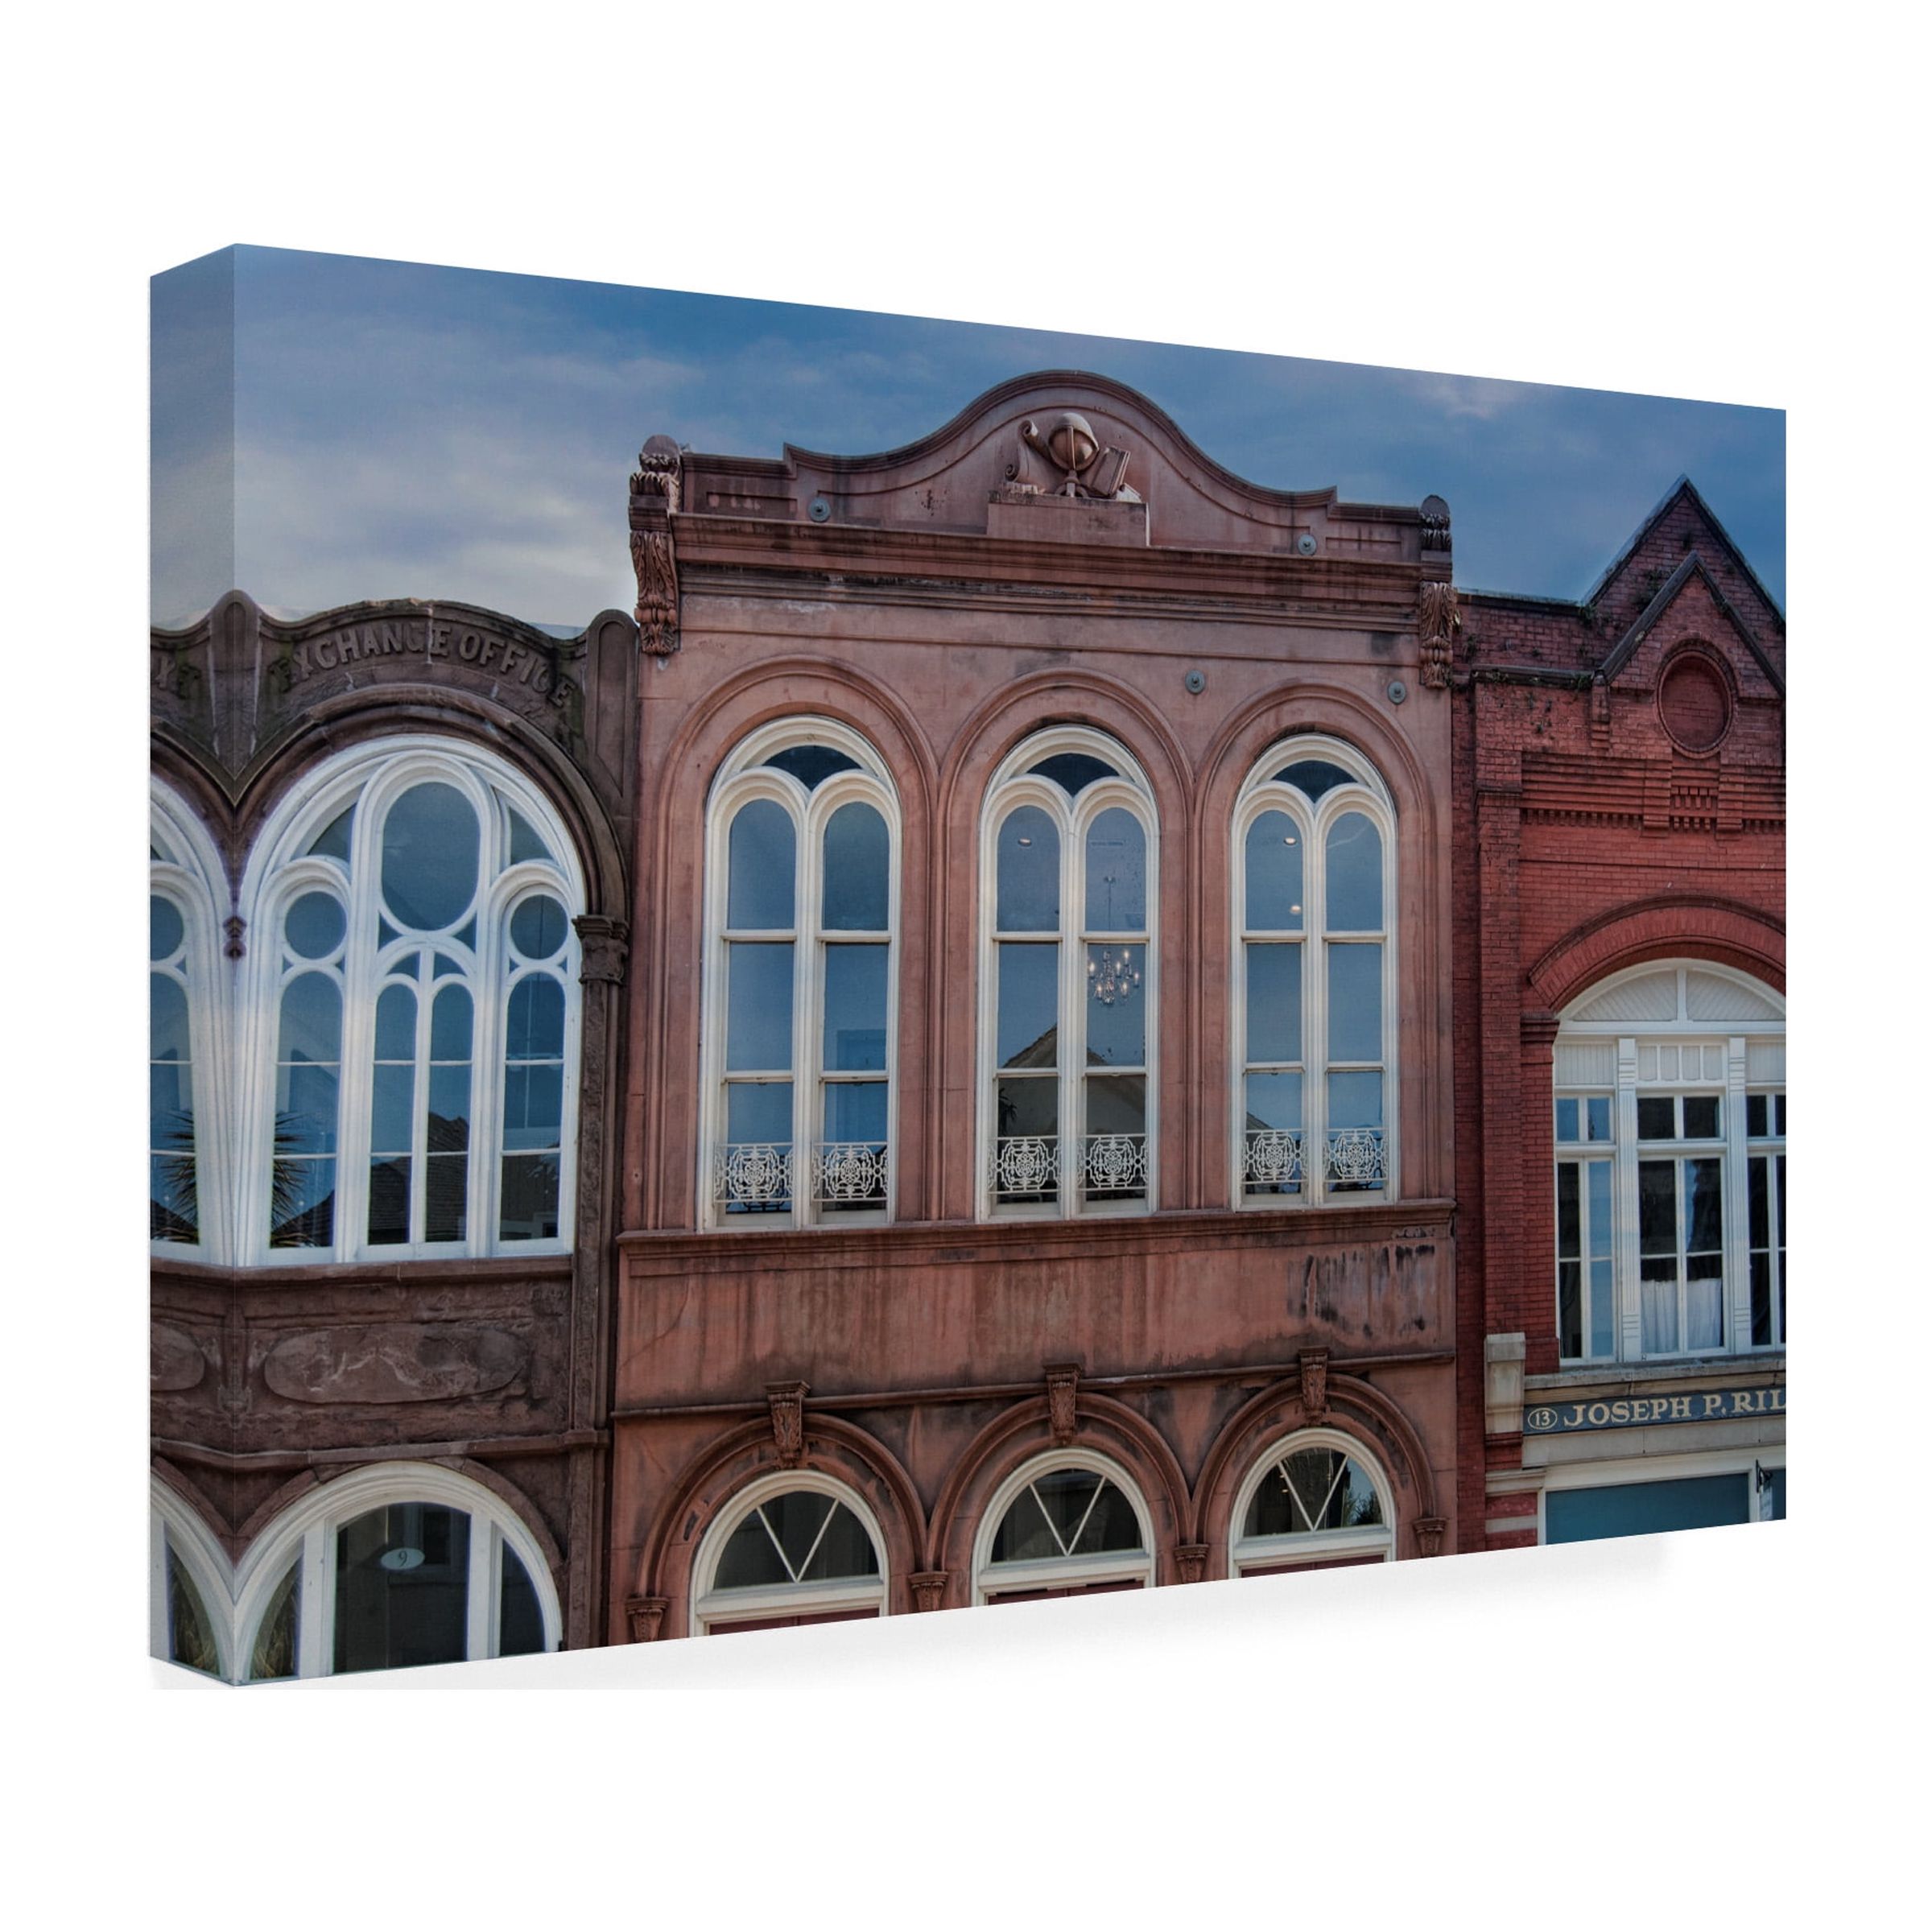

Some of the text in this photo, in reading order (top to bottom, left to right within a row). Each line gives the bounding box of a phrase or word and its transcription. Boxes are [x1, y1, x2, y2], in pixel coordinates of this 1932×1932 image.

[459, 630, 576, 708] OFFICE
[1535, 1389, 1785, 1427] 13 JOSEPH P. RIL
[398, 1550, 408, 1567] 9
